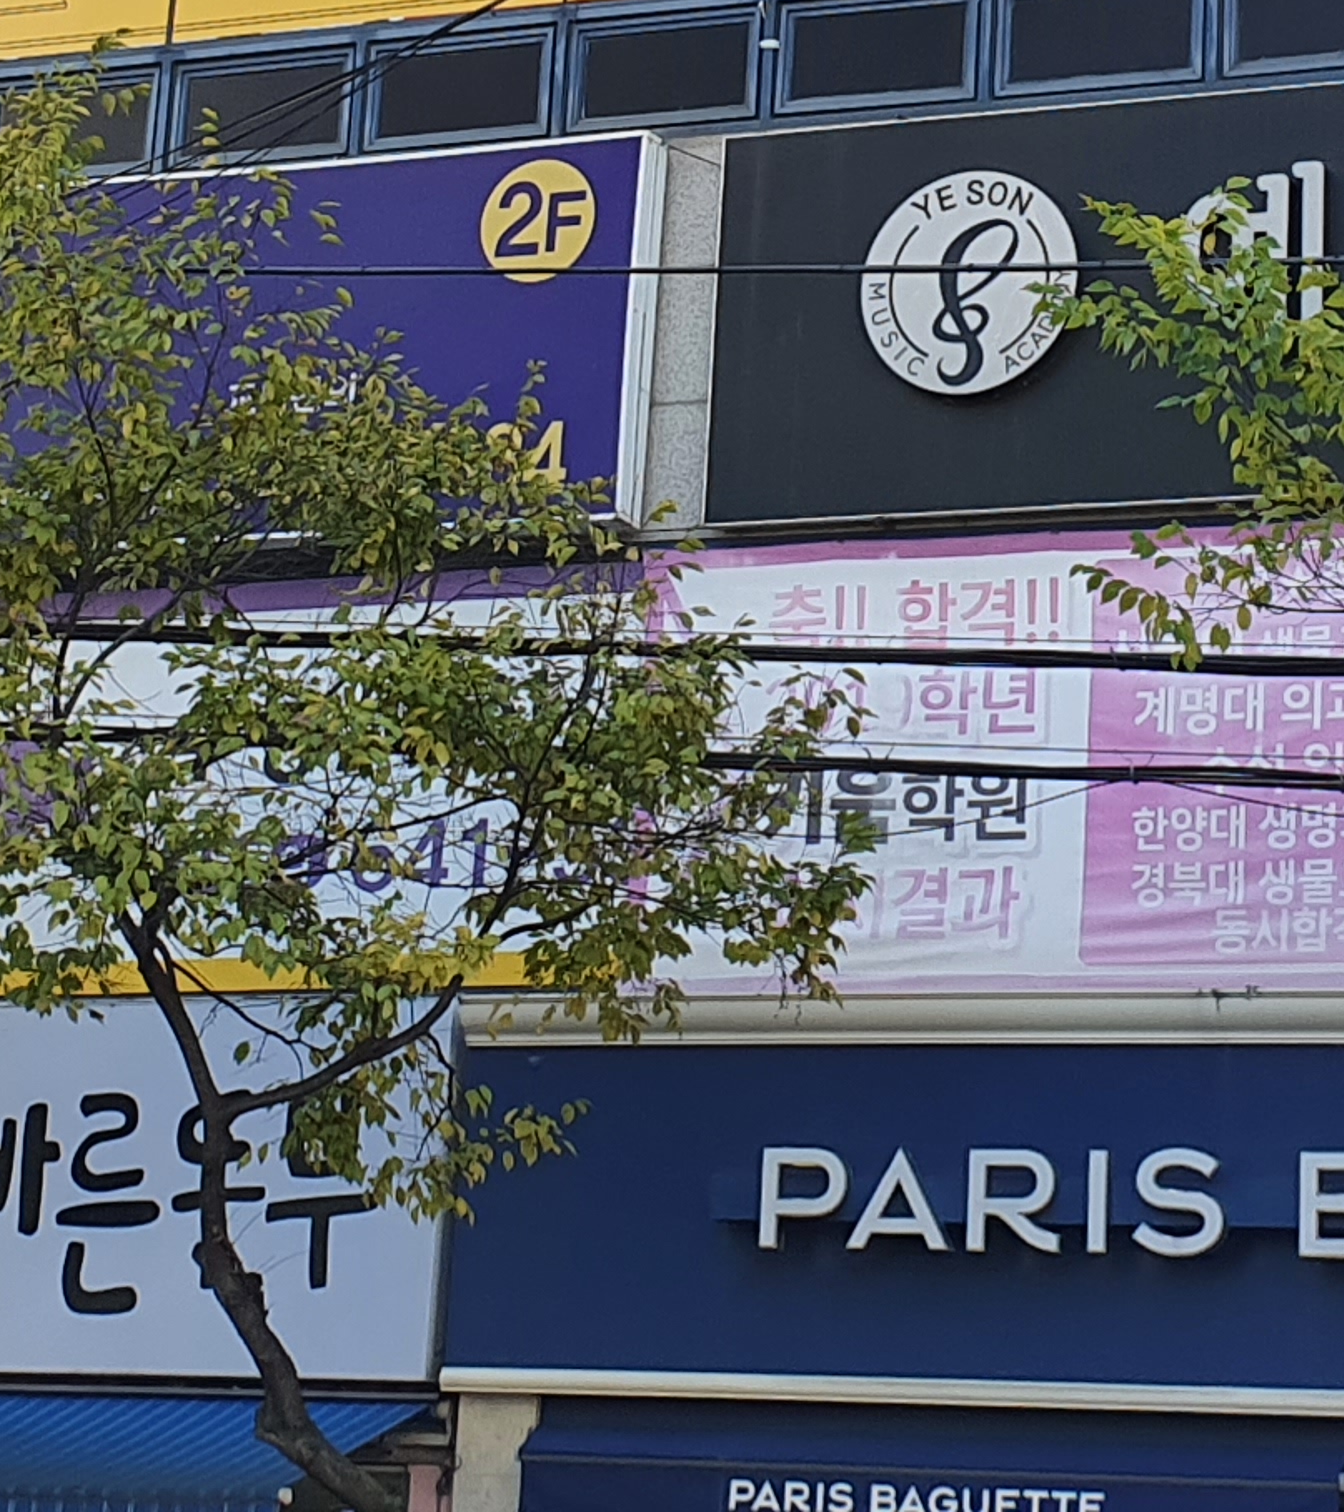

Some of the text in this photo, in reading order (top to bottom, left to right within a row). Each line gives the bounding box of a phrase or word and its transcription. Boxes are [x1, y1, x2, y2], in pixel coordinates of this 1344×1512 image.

[492, 181, 588, 260] 2F
[910, 179, 1034, 221] YE SON
[868, 281, 926, 377] MUSIC
[1135, 682, 1265, 736] 계명대
[1131, 806, 1247, 853] 한양대
[1131, 859, 1246, 909] 경북대
[758, 1145, 1229, 1258] PARIS
[728, 1478, 854, 1512] PARIS
